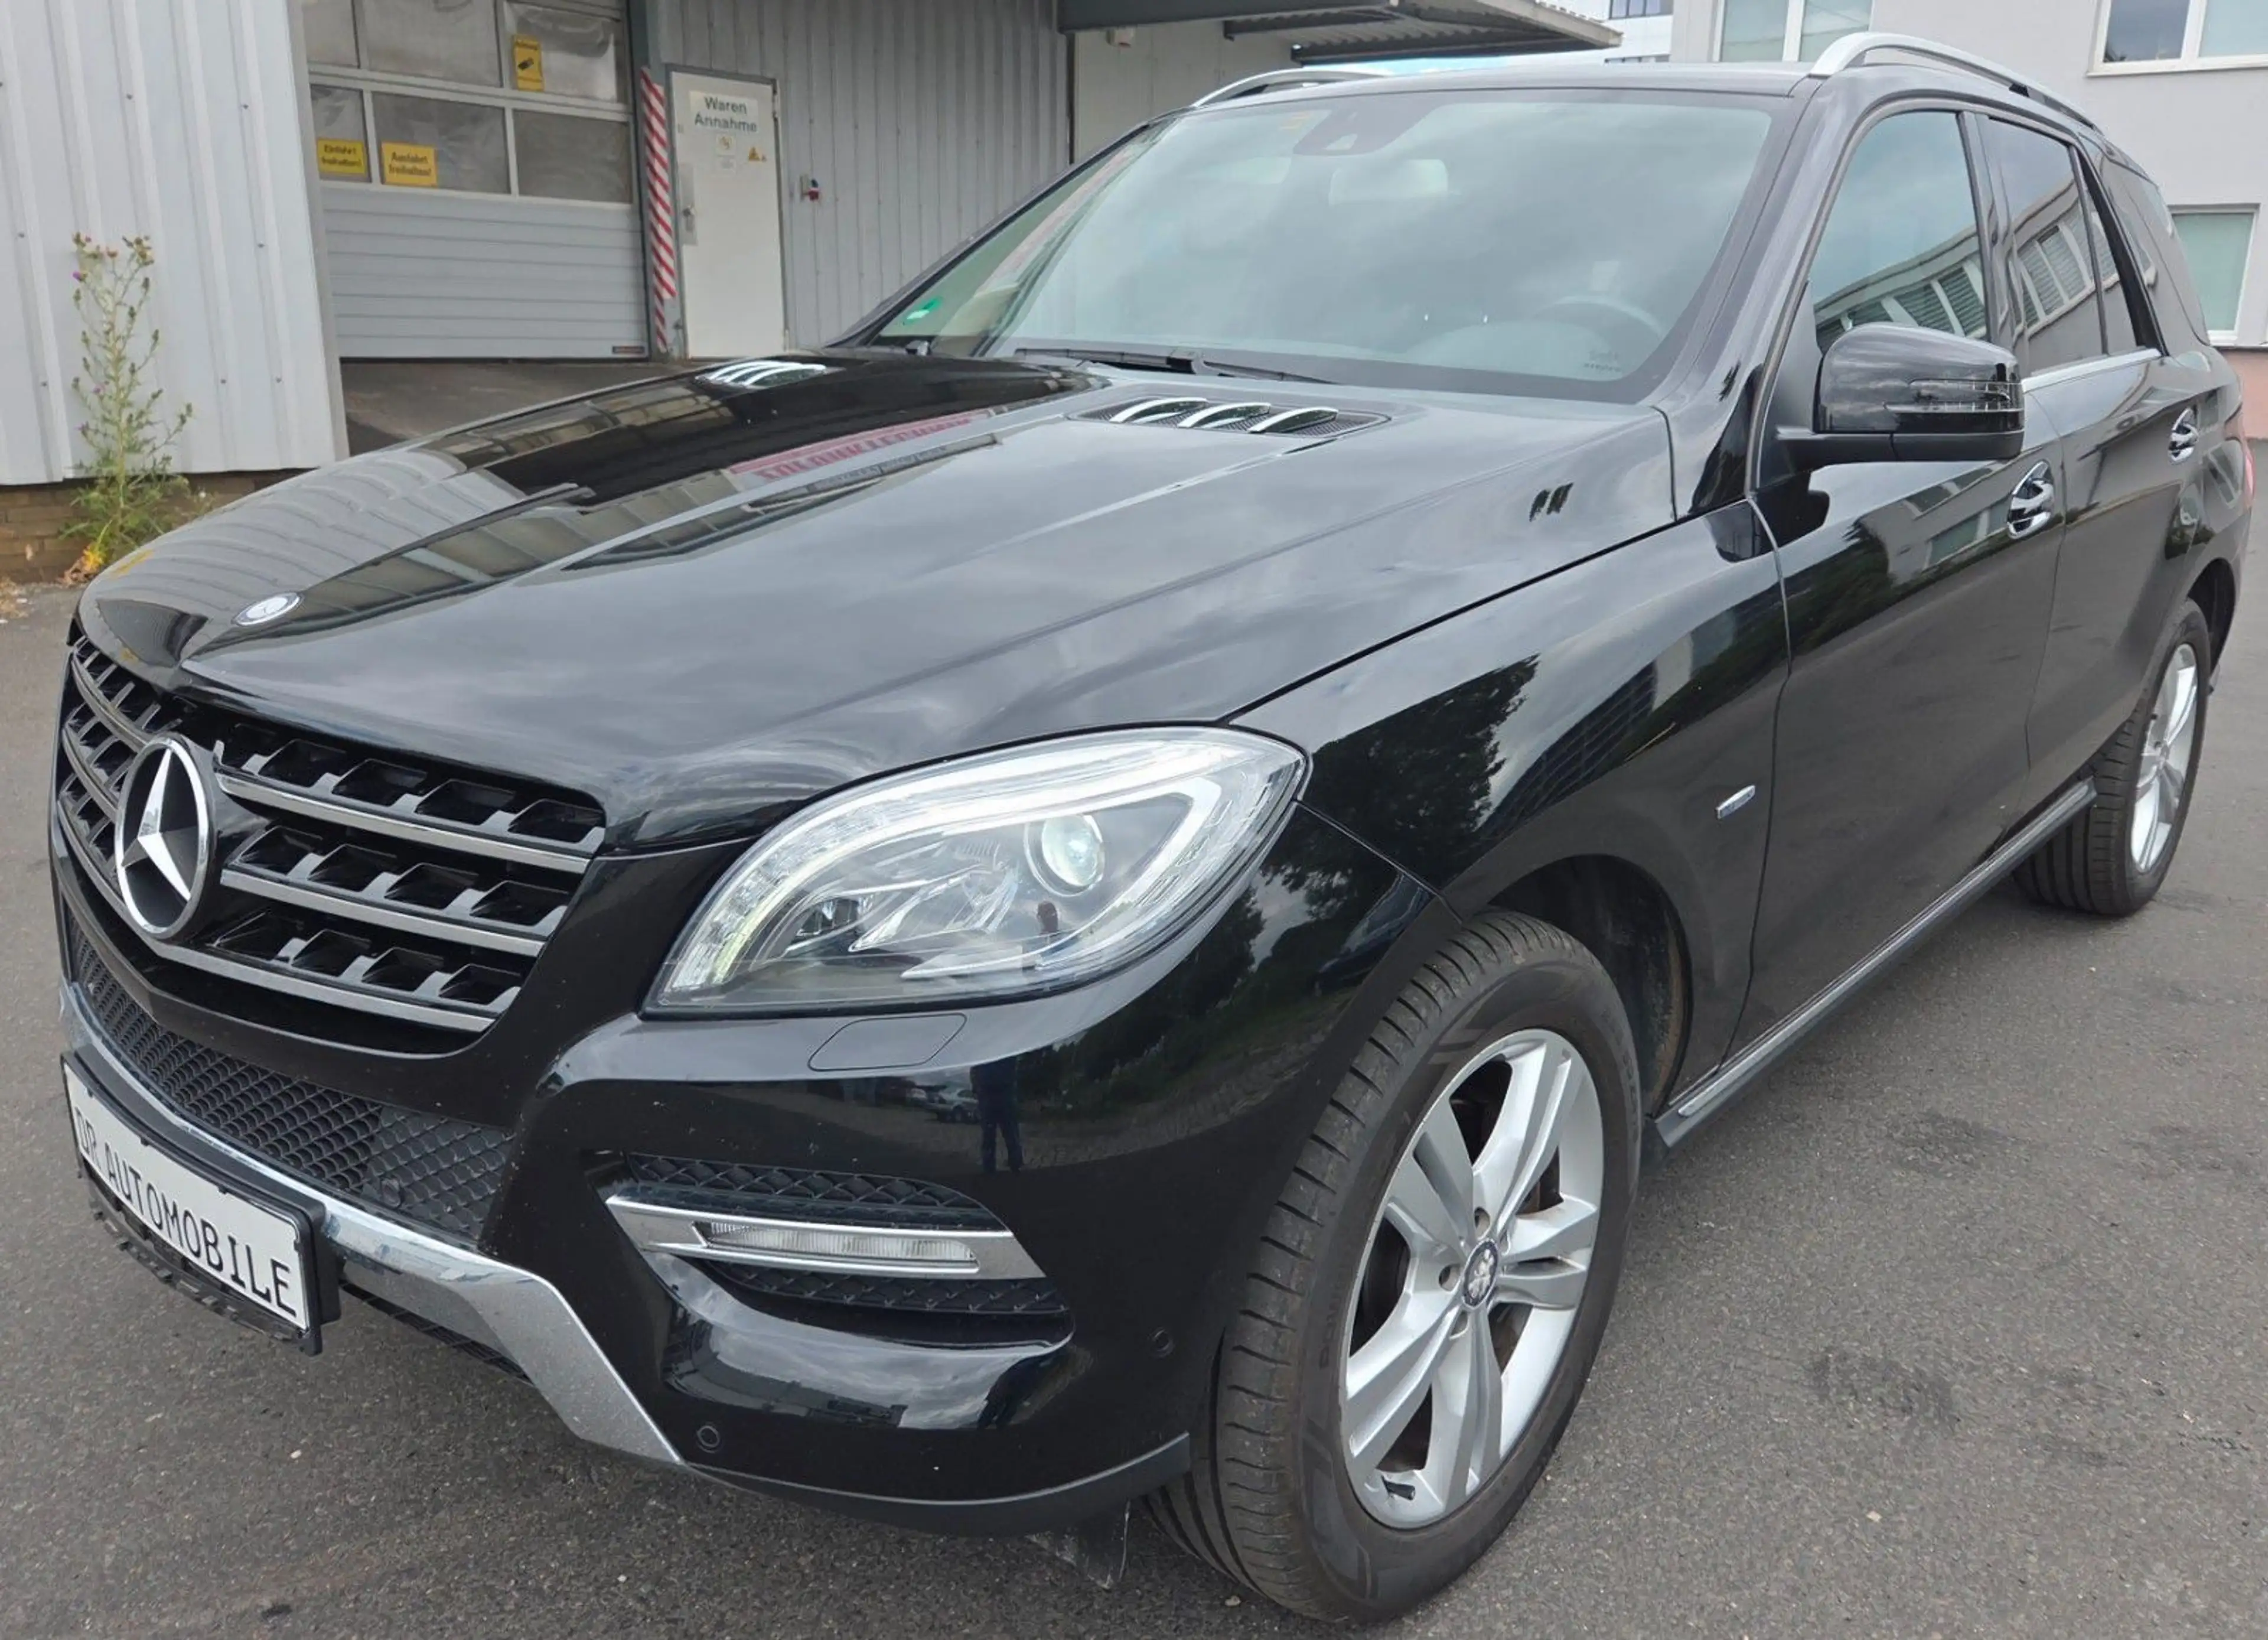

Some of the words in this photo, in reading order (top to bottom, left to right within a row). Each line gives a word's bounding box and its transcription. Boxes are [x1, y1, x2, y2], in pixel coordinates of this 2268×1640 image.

[703, 96, 747, 116] Waren
[695, 111, 757, 132] Annahme
[105, 1141, 296, 1317] AUTOMOBILE
